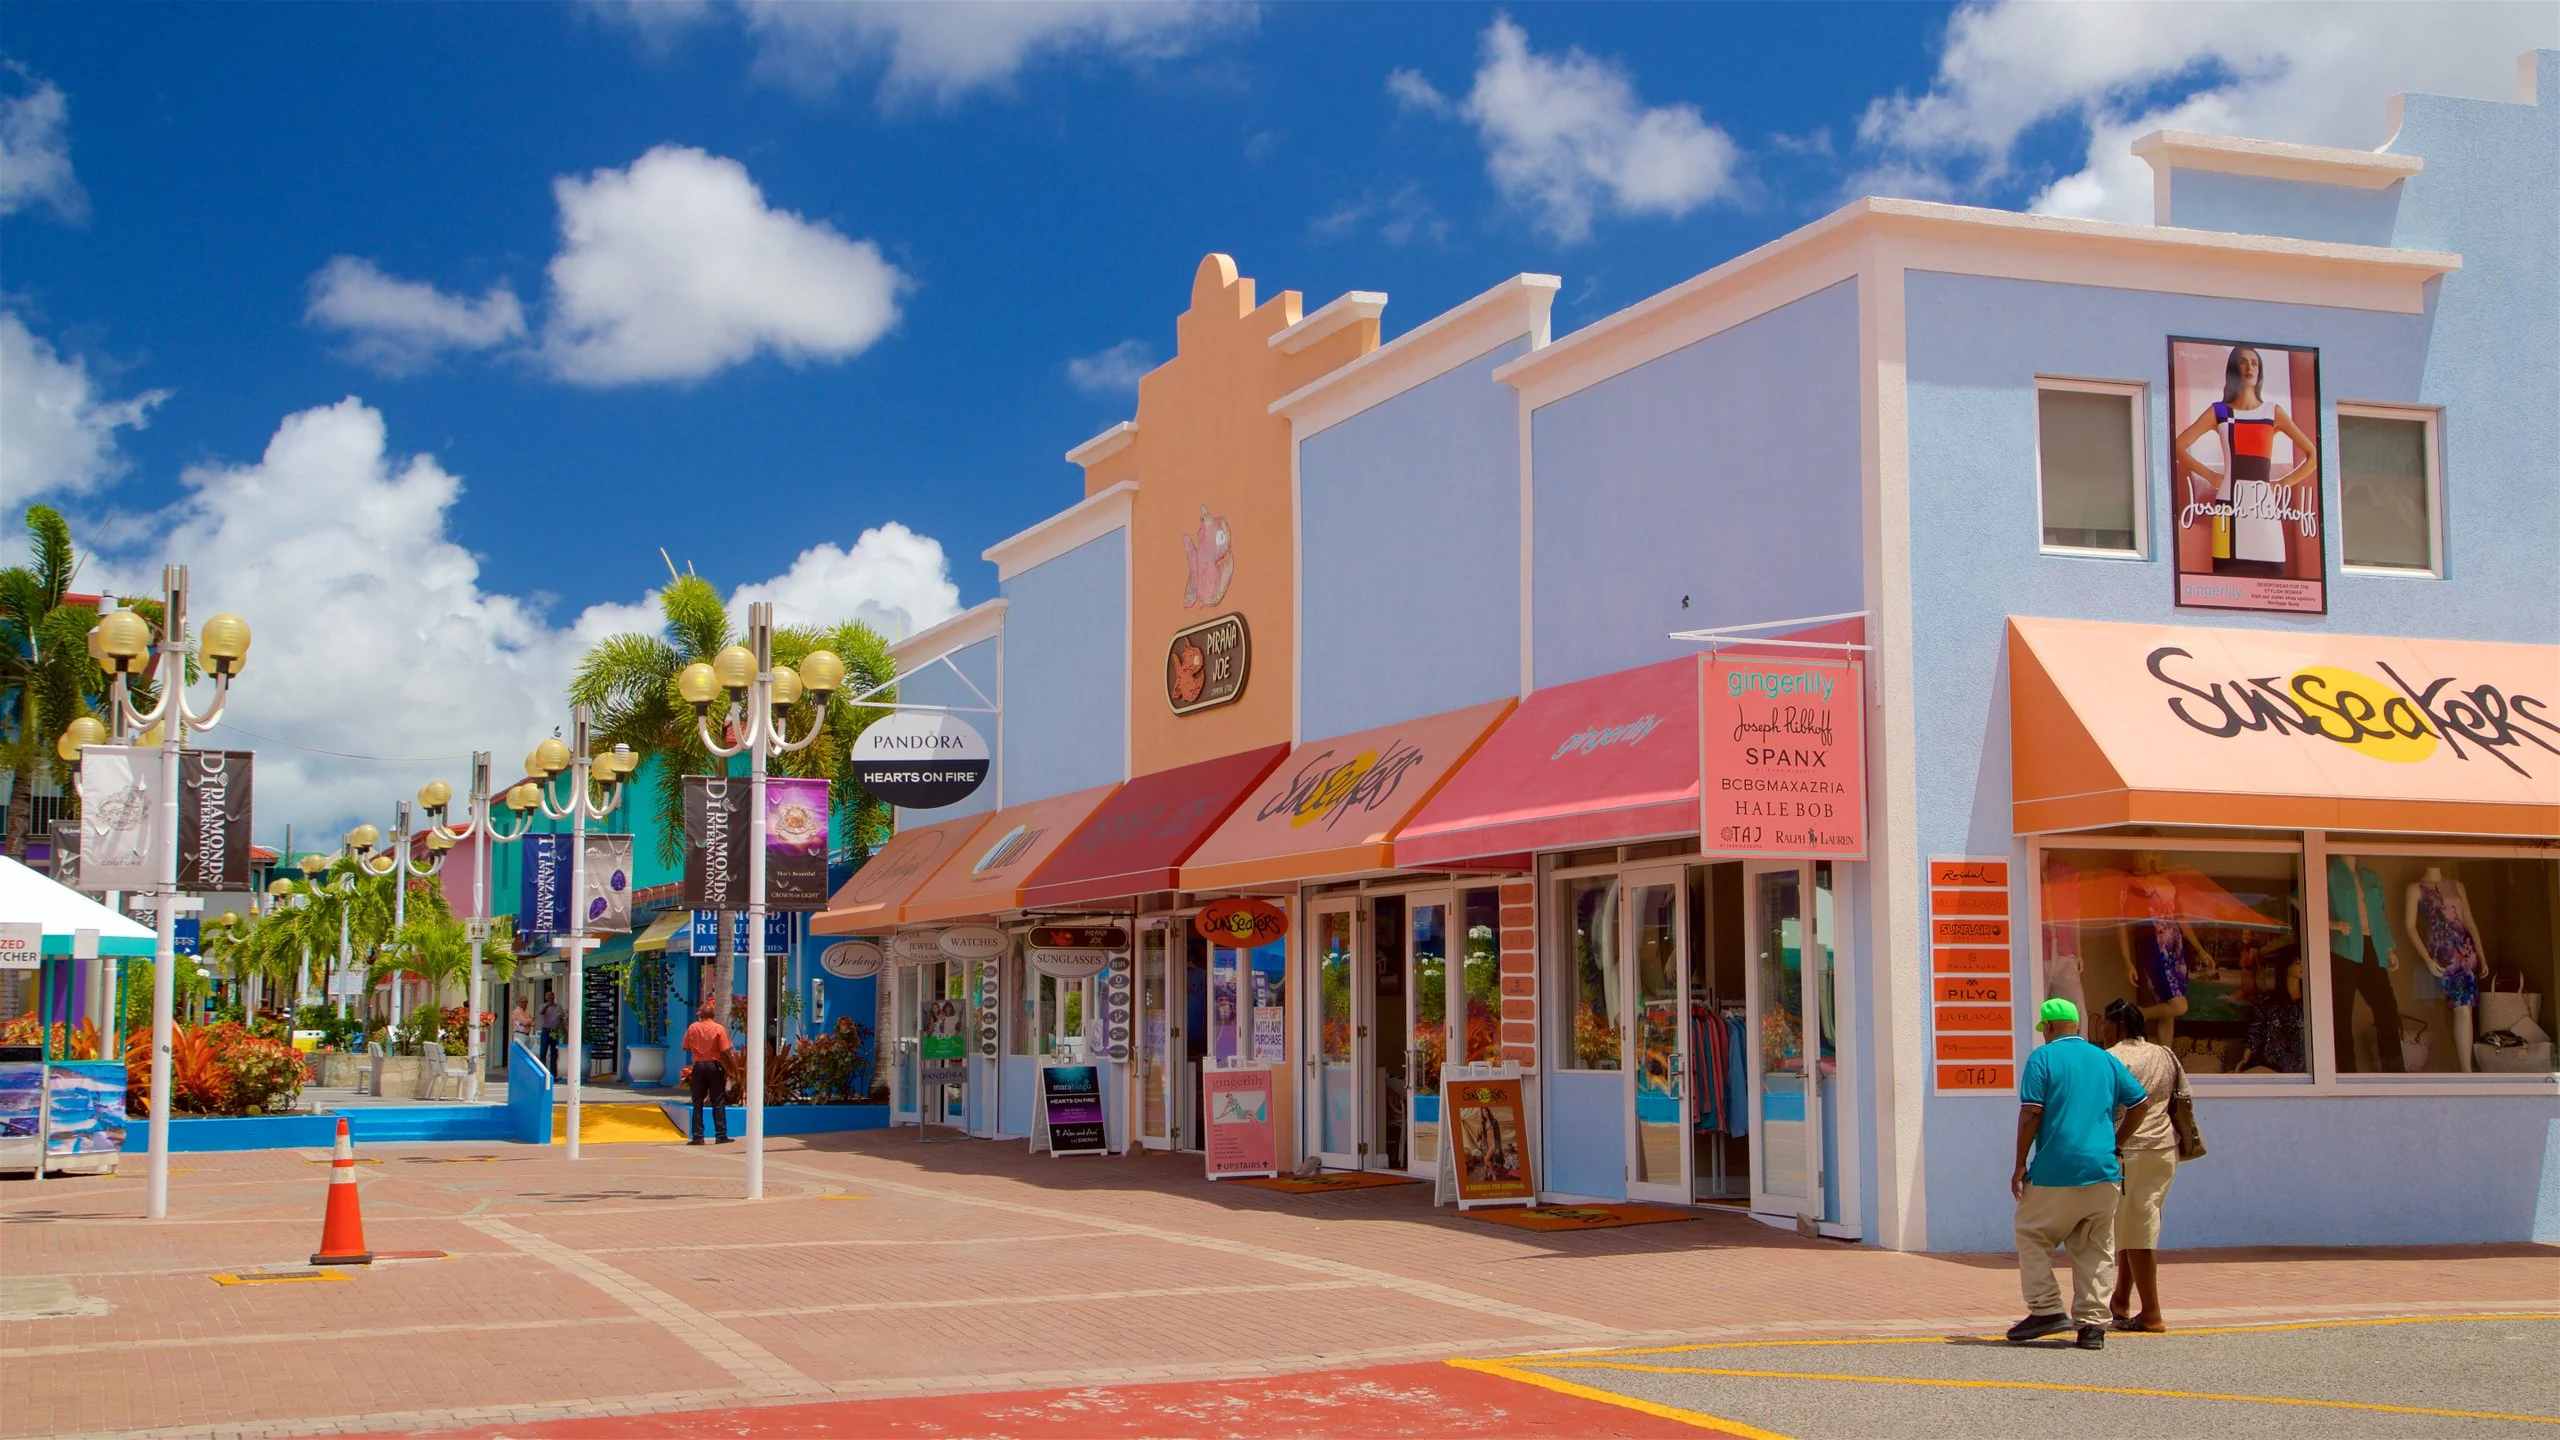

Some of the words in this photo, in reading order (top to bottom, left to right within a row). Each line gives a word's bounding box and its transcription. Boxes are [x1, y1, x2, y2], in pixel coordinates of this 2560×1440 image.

[2181, 476, 2248, 533] Joseph
[2249, 480, 2317, 538] Ribkoff
[2184, 584, 2243, 600] gingerlily
[1212, 656, 1230, 682] JOE
[1728, 667, 1835, 700] gingerlily
[1733, 704, 1782, 744] Joseph
[1783, 706, 1833, 746] Ribkoff
[873, 735, 964, 749] PANDORA
[1551, 713, 1664, 761] gingerlily
[1745, 747, 1827, 767] SPANX
[864, 772, 920, 782] HEARTS
[922, 772, 943, 782] ON
[945, 772, 975, 782] FIRE
[1721, 778, 1845, 794] BCBGMAXAZRIA
[1735, 801, 1790, 817] HALE
[1796, 802, 1834, 818] BOB
[198, 787, 211, 884] INTERNATIONAL
[209, 787, 226, 884] DIAMONDS
[1731, 826, 1763, 843] TAJ
[704, 812, 717, 902] INTERNATIONAL
[713, 812, 729, 903] DIAMONDS
[1942, 865, 1998, 884] Roidal
[696, 923, 786, 935] REUIC
[1940, 924, 1992, 936] SUNFLAIR
[950, 937, 999, 948] WATCHES
[1089, 936, 1103, 944] JOE
[828, 947, 882, 968] Sterlings
[1037, 953, 1103, 965] SUNGLASSES
[1948, 989, 1998, 1000] PILYQ
[1255, 1007, 1269, 1020] FREE
[1269, 1007, 1282, 1020] GIFT
[1940, 1013, 1956, 1021] LA
[1958, 1013, 2004, 1021] BLANCA
[1255, 1021, 1271, 1034] WITH
[1270, 1021, 1282, 1034] ANY
[1255, 1034, 1282, 1046] PURCHASE
[1212, 1075, 1265, 1090] gingerlily
[1967, 1068, 1997, 1085] TAJ
[1223, 1162, 1262, 1171] UPSTAIRS
